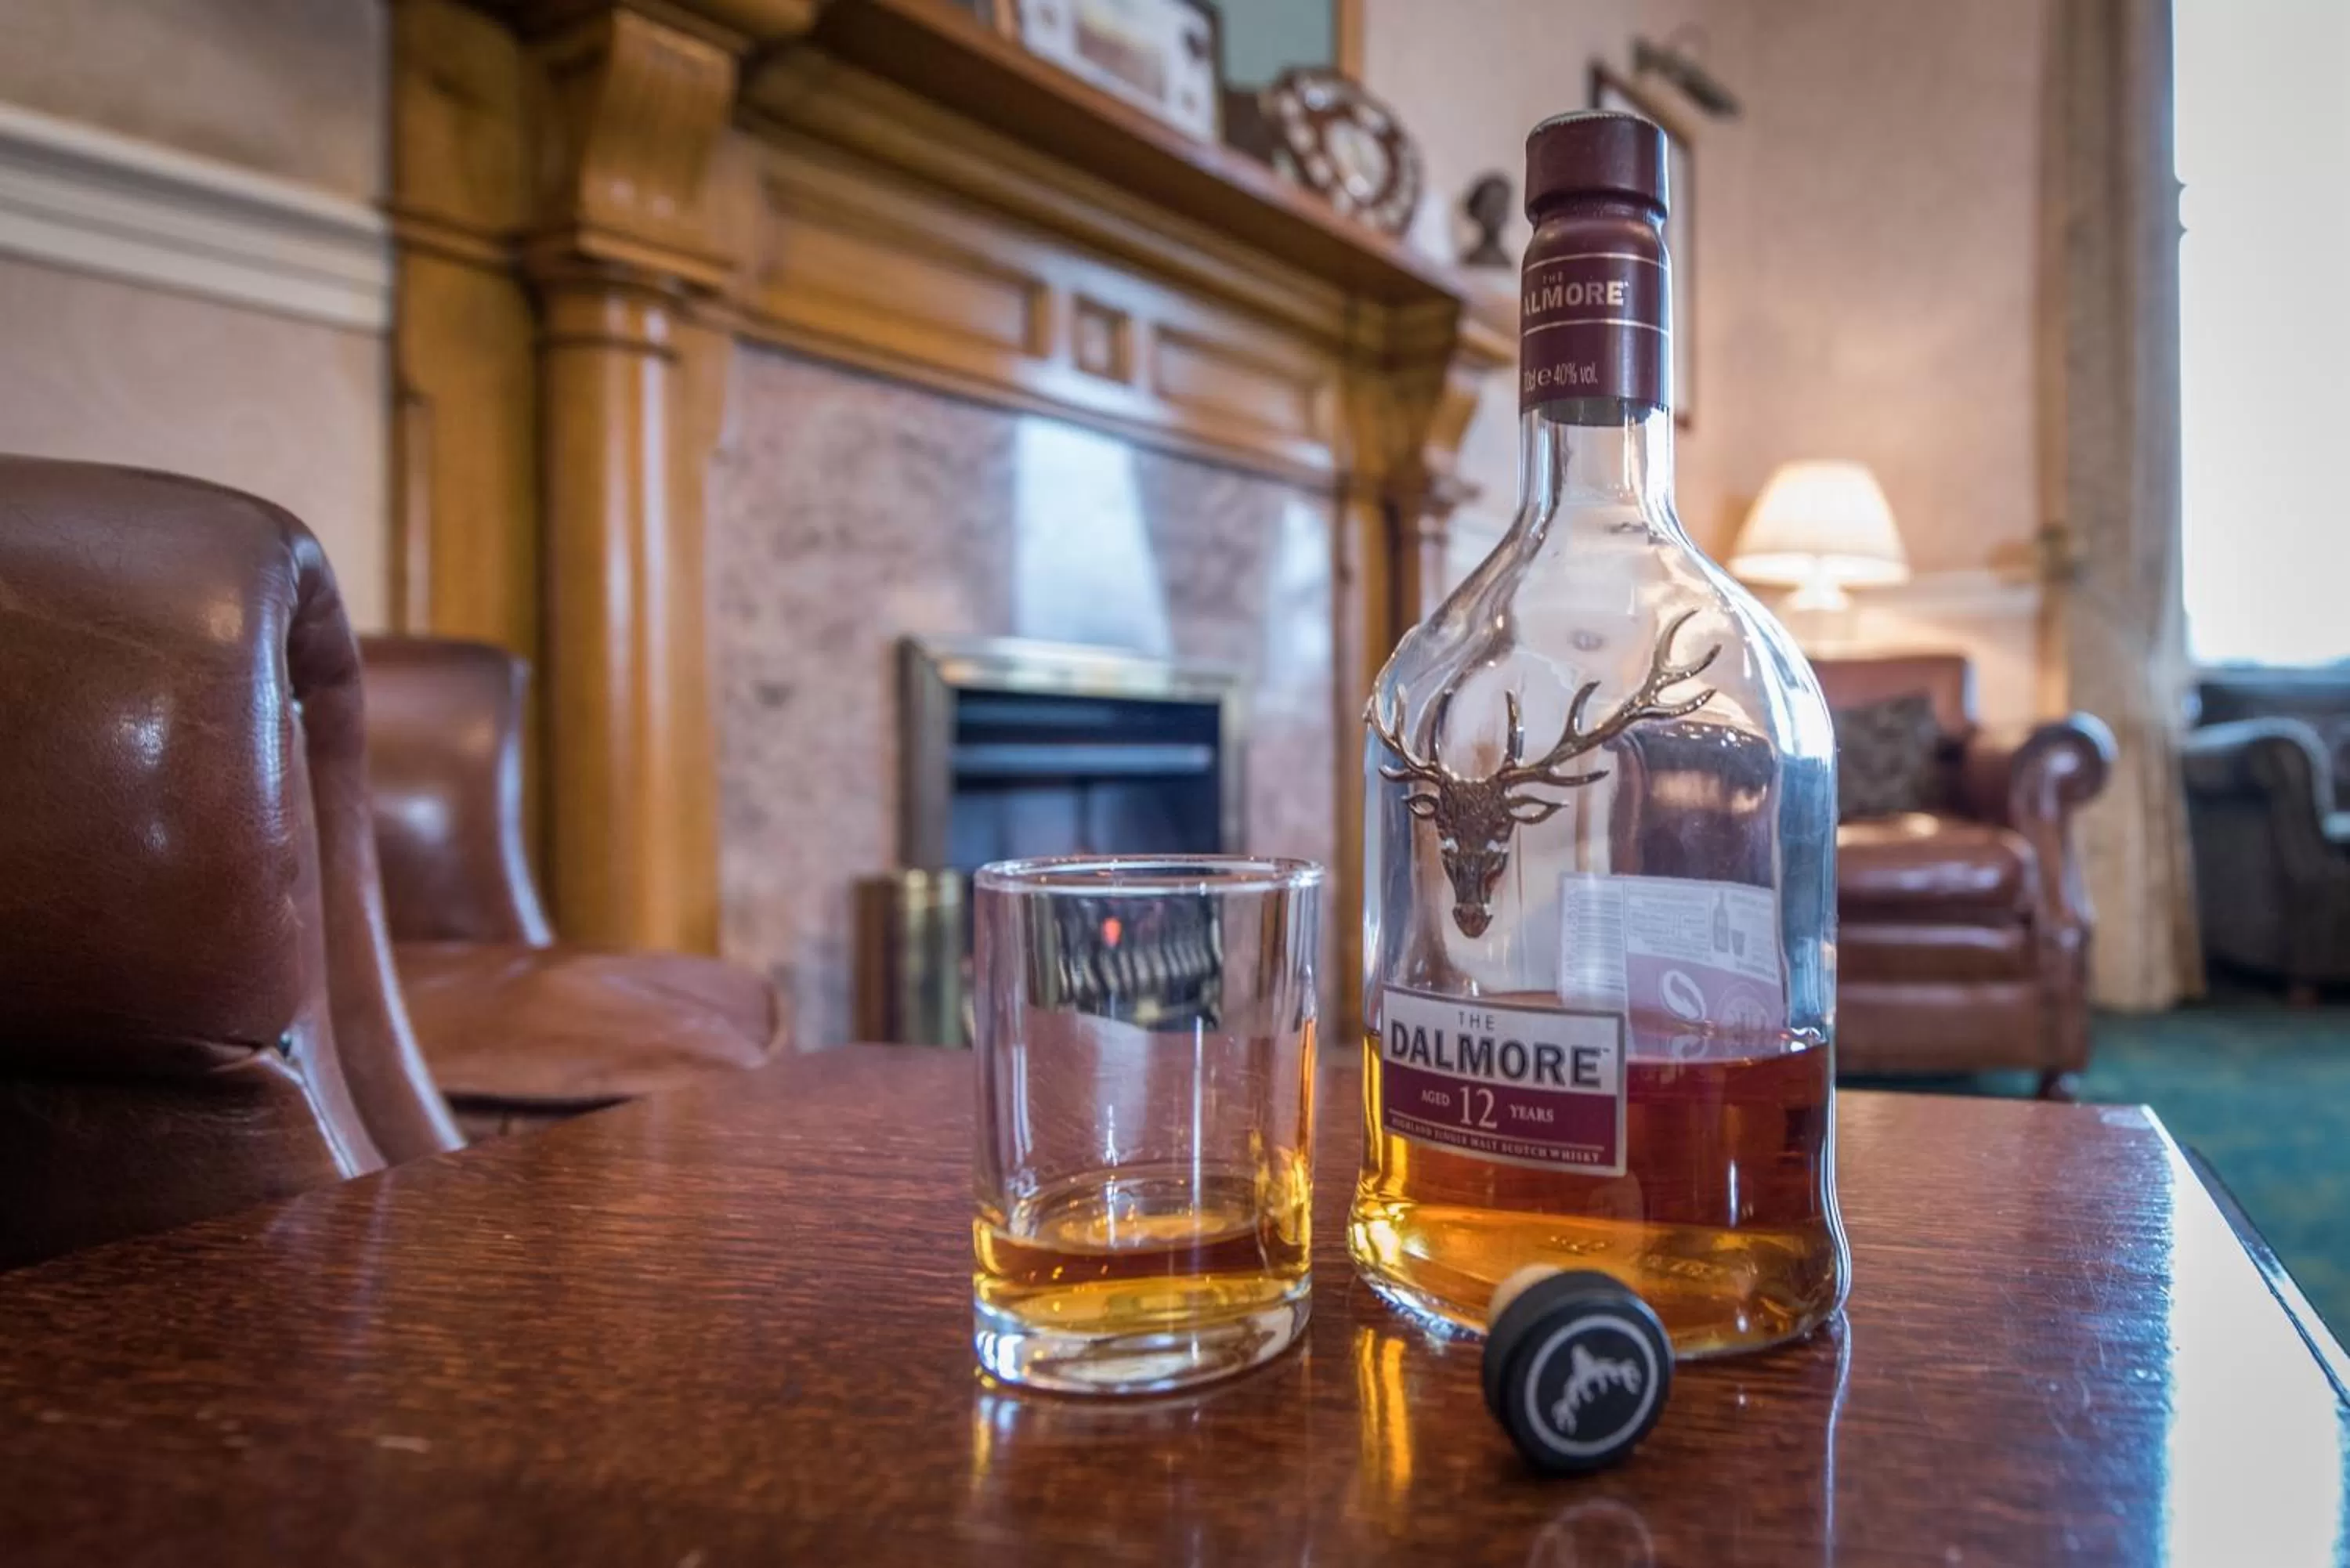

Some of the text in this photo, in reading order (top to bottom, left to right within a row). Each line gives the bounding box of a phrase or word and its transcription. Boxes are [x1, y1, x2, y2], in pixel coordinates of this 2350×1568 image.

[1524, 280, 1624, 316] ALMORE
[1553, 363, 1578, 385] 40%
[1459, 1010, 1495, 1032] THE
[1390, 1019, 1602, 1089] DALMORE
[1421, 1085, 1554, 1129] AGED 12 YEARS
